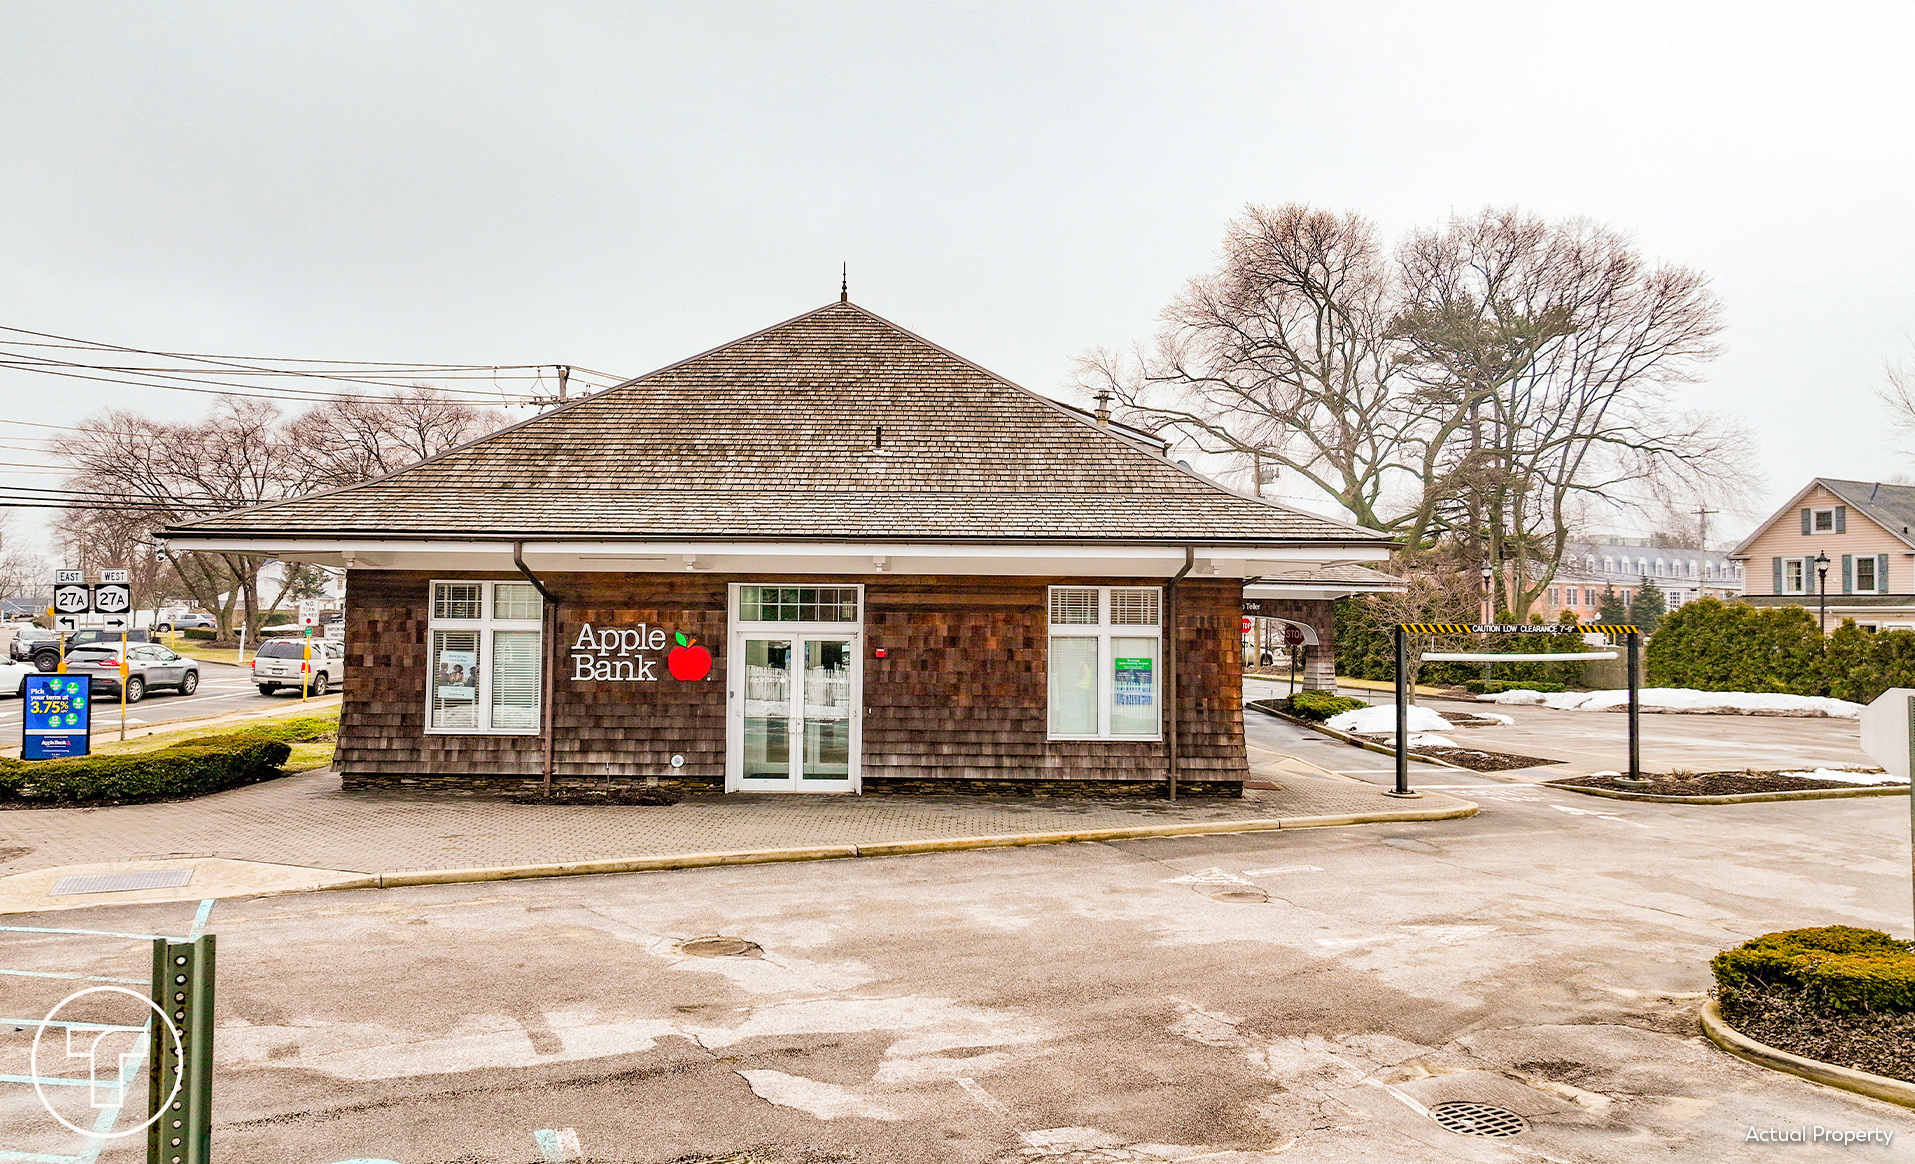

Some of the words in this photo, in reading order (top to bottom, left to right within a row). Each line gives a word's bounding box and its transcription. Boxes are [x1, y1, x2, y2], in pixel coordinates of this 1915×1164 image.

[60, 572, 79, 581] EAST
[104, 572, 125, 581] WEST
[60, 592, 84, 606] 27A
[100, 592, 125, 606] 27A
[1472, 624, 1501, 633] CAUTION
[1503, 624, 1518, 633] LOW
[1520, 624, 1558, 633] CLEARANCE
[570, 622, 667, 657] Apple
[570, 653, 658, 681] Bank
[30, 700, 69, 714] 3.75%
